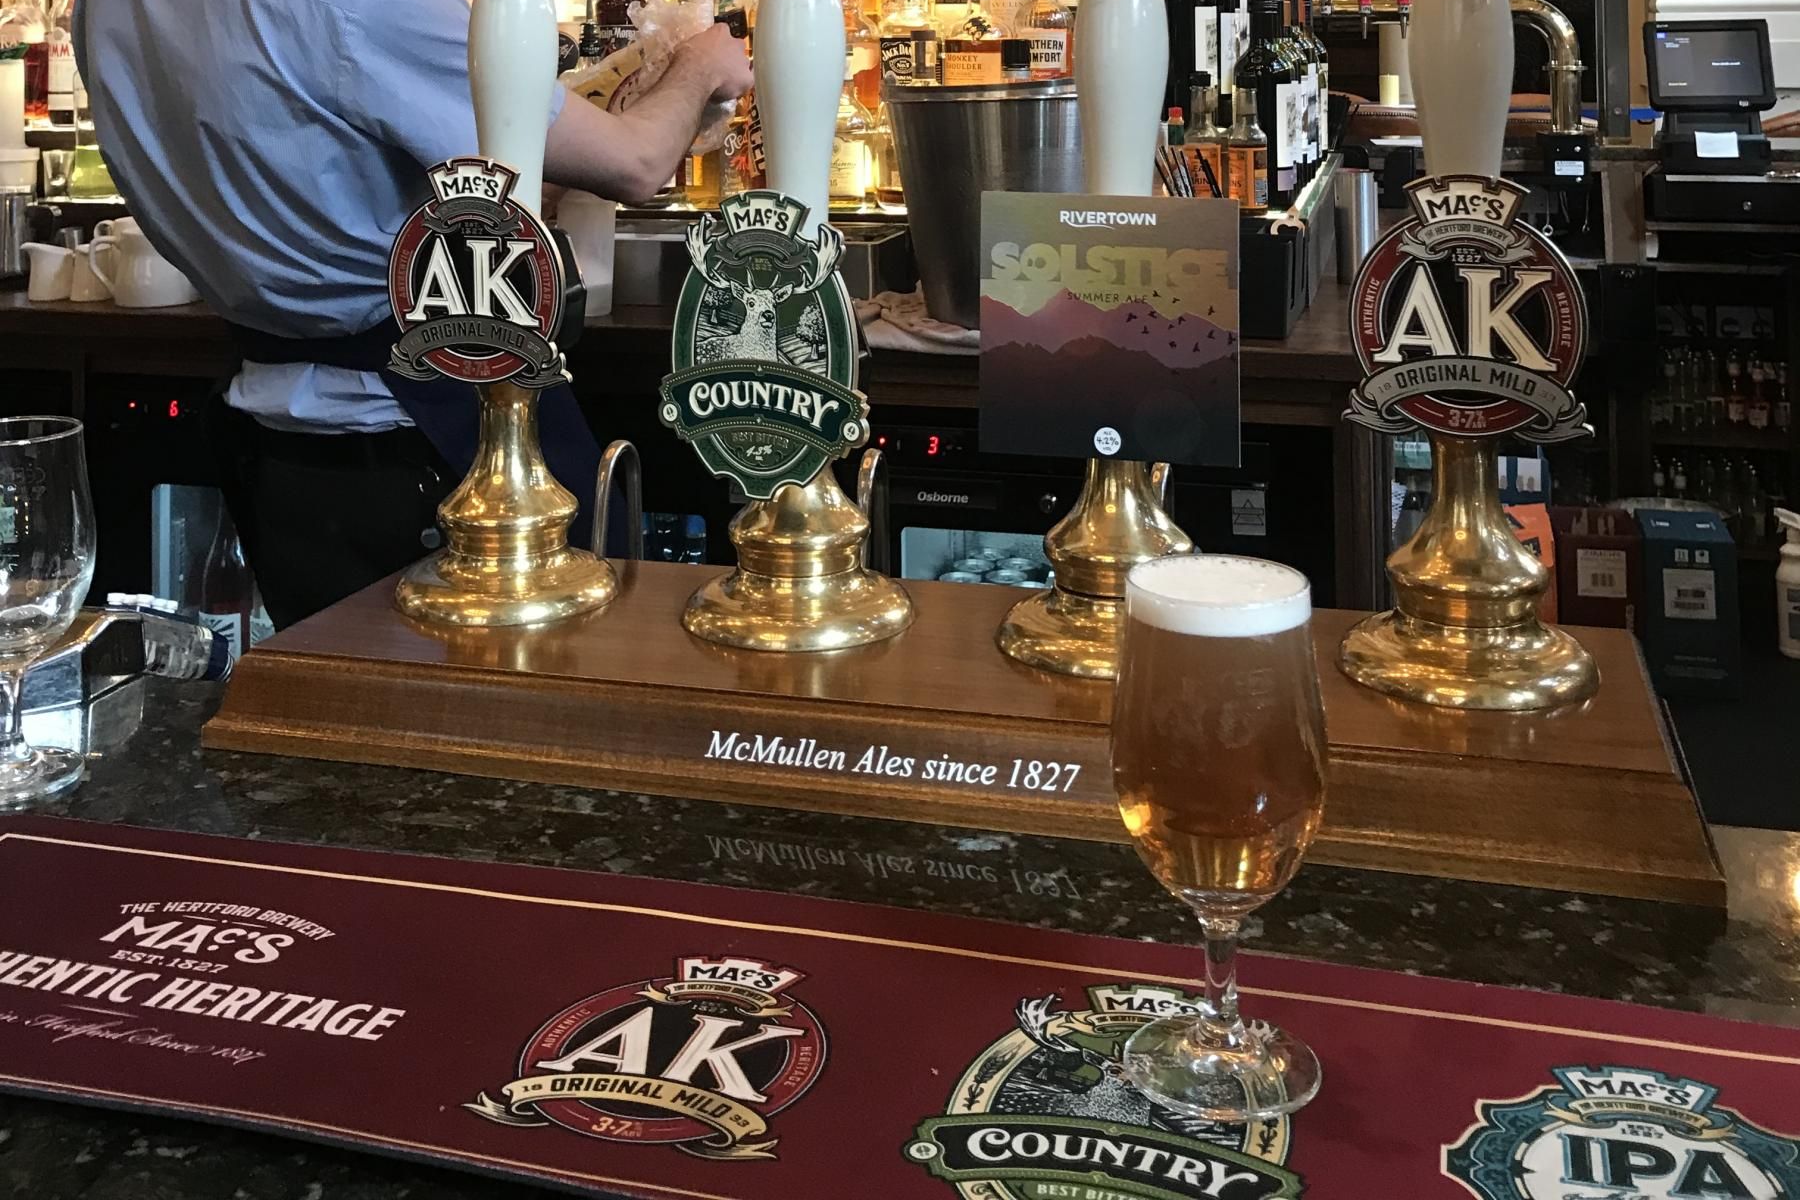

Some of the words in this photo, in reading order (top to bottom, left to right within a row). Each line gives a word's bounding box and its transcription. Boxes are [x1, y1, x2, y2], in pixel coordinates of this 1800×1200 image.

[1060, 210, 1157, 229] RIVERTOWN
[1435, 223, 1472, 236] HERTFORD
[1472, 224, 1509, 242] BREWERY
[991, 241, 1234, 290] SOLSTICE
[1451, 254, 1482, 263] 1827
[405, 238, 540, 327] AK
[1067, 291, 1120, 304] SUMMER
[1126, 294, 1149, 305] ALE
[422, 323, 486, 345] ORIGINAL
[490, 325, 526, 349] MILD
[1363, 278, 1379, 335] AUTHENTIC
[1556, 291, 1571, 349] HERITAGE
[1373, 265, 1557, 372] AK
[1395, 364, 1482, 389] ORIGINAL
[1489, 369, 1537, 396] MILD
[168, 400, 179, 418] 6
[689, 380, 840, 432] COUNTRY
[926, 435, 939, 456] 3
[1096, 435, 1120, 448] 4.2%
[917, 490, 969, 505] Osborne
[704, 730, 846, 772] McMullen
[852, 745, 915, 778] Ales
[921, 753, 998, 785] since
[1004, 758, 1082, 793] 1827
[119, 901, 161, 915] THE
[162, 900, 262, 919] HERTFORD
[259, 909, 337, 942] BREWERY
[0, 951, 161, 1004] HENTIC
[140, 977, 407, 1042] HERITAGE
[536, 1006, 806, 1103] AK
[541, 1007, 591, 1049] AUTHENTIC
[783, 1046, 813, 1088] HERITAGE
[550, 1077, 663, 1100] ORIGINAL
[671, 1090, 732, 1119] MILD
[729, 1113, 750, 1128] 33
[967, 1128, 1259, 1199] COUNTRY
[1559, 1132, 1754, 1200] IPA
[1037, 1184, 1079, 1197] BEST
